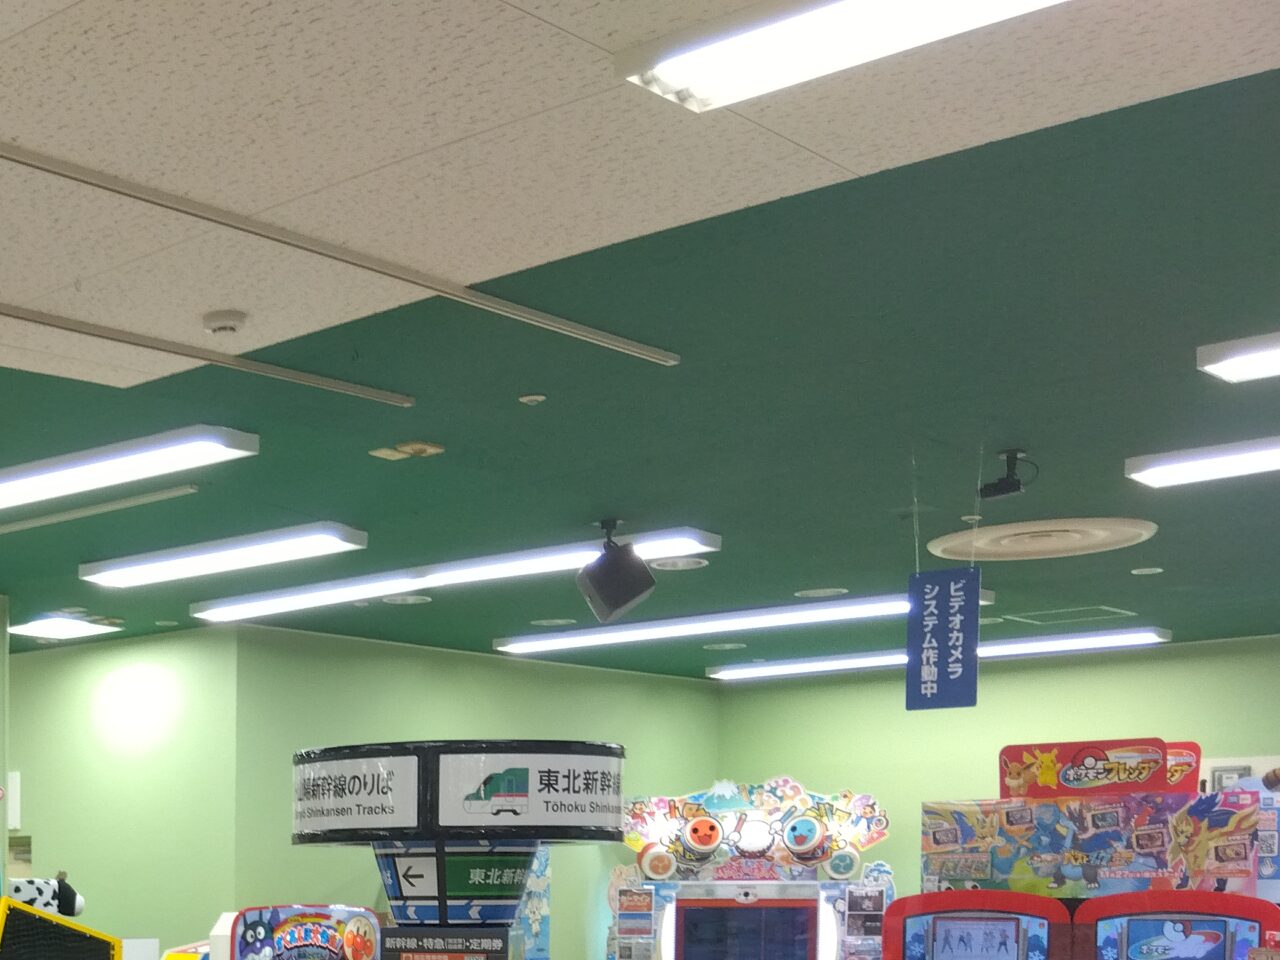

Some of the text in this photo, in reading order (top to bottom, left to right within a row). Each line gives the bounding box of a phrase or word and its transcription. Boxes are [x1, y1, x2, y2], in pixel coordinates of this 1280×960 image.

[920, 584, 939, 698] システム作動中
[946, 579, 967, 680] ビデオカメラ
[1066, 761, 1161, 782] ポケモンフレンダ
[306, 805, 353, 819] Shinkansen
[355, 803, 395, 816] Tracks
